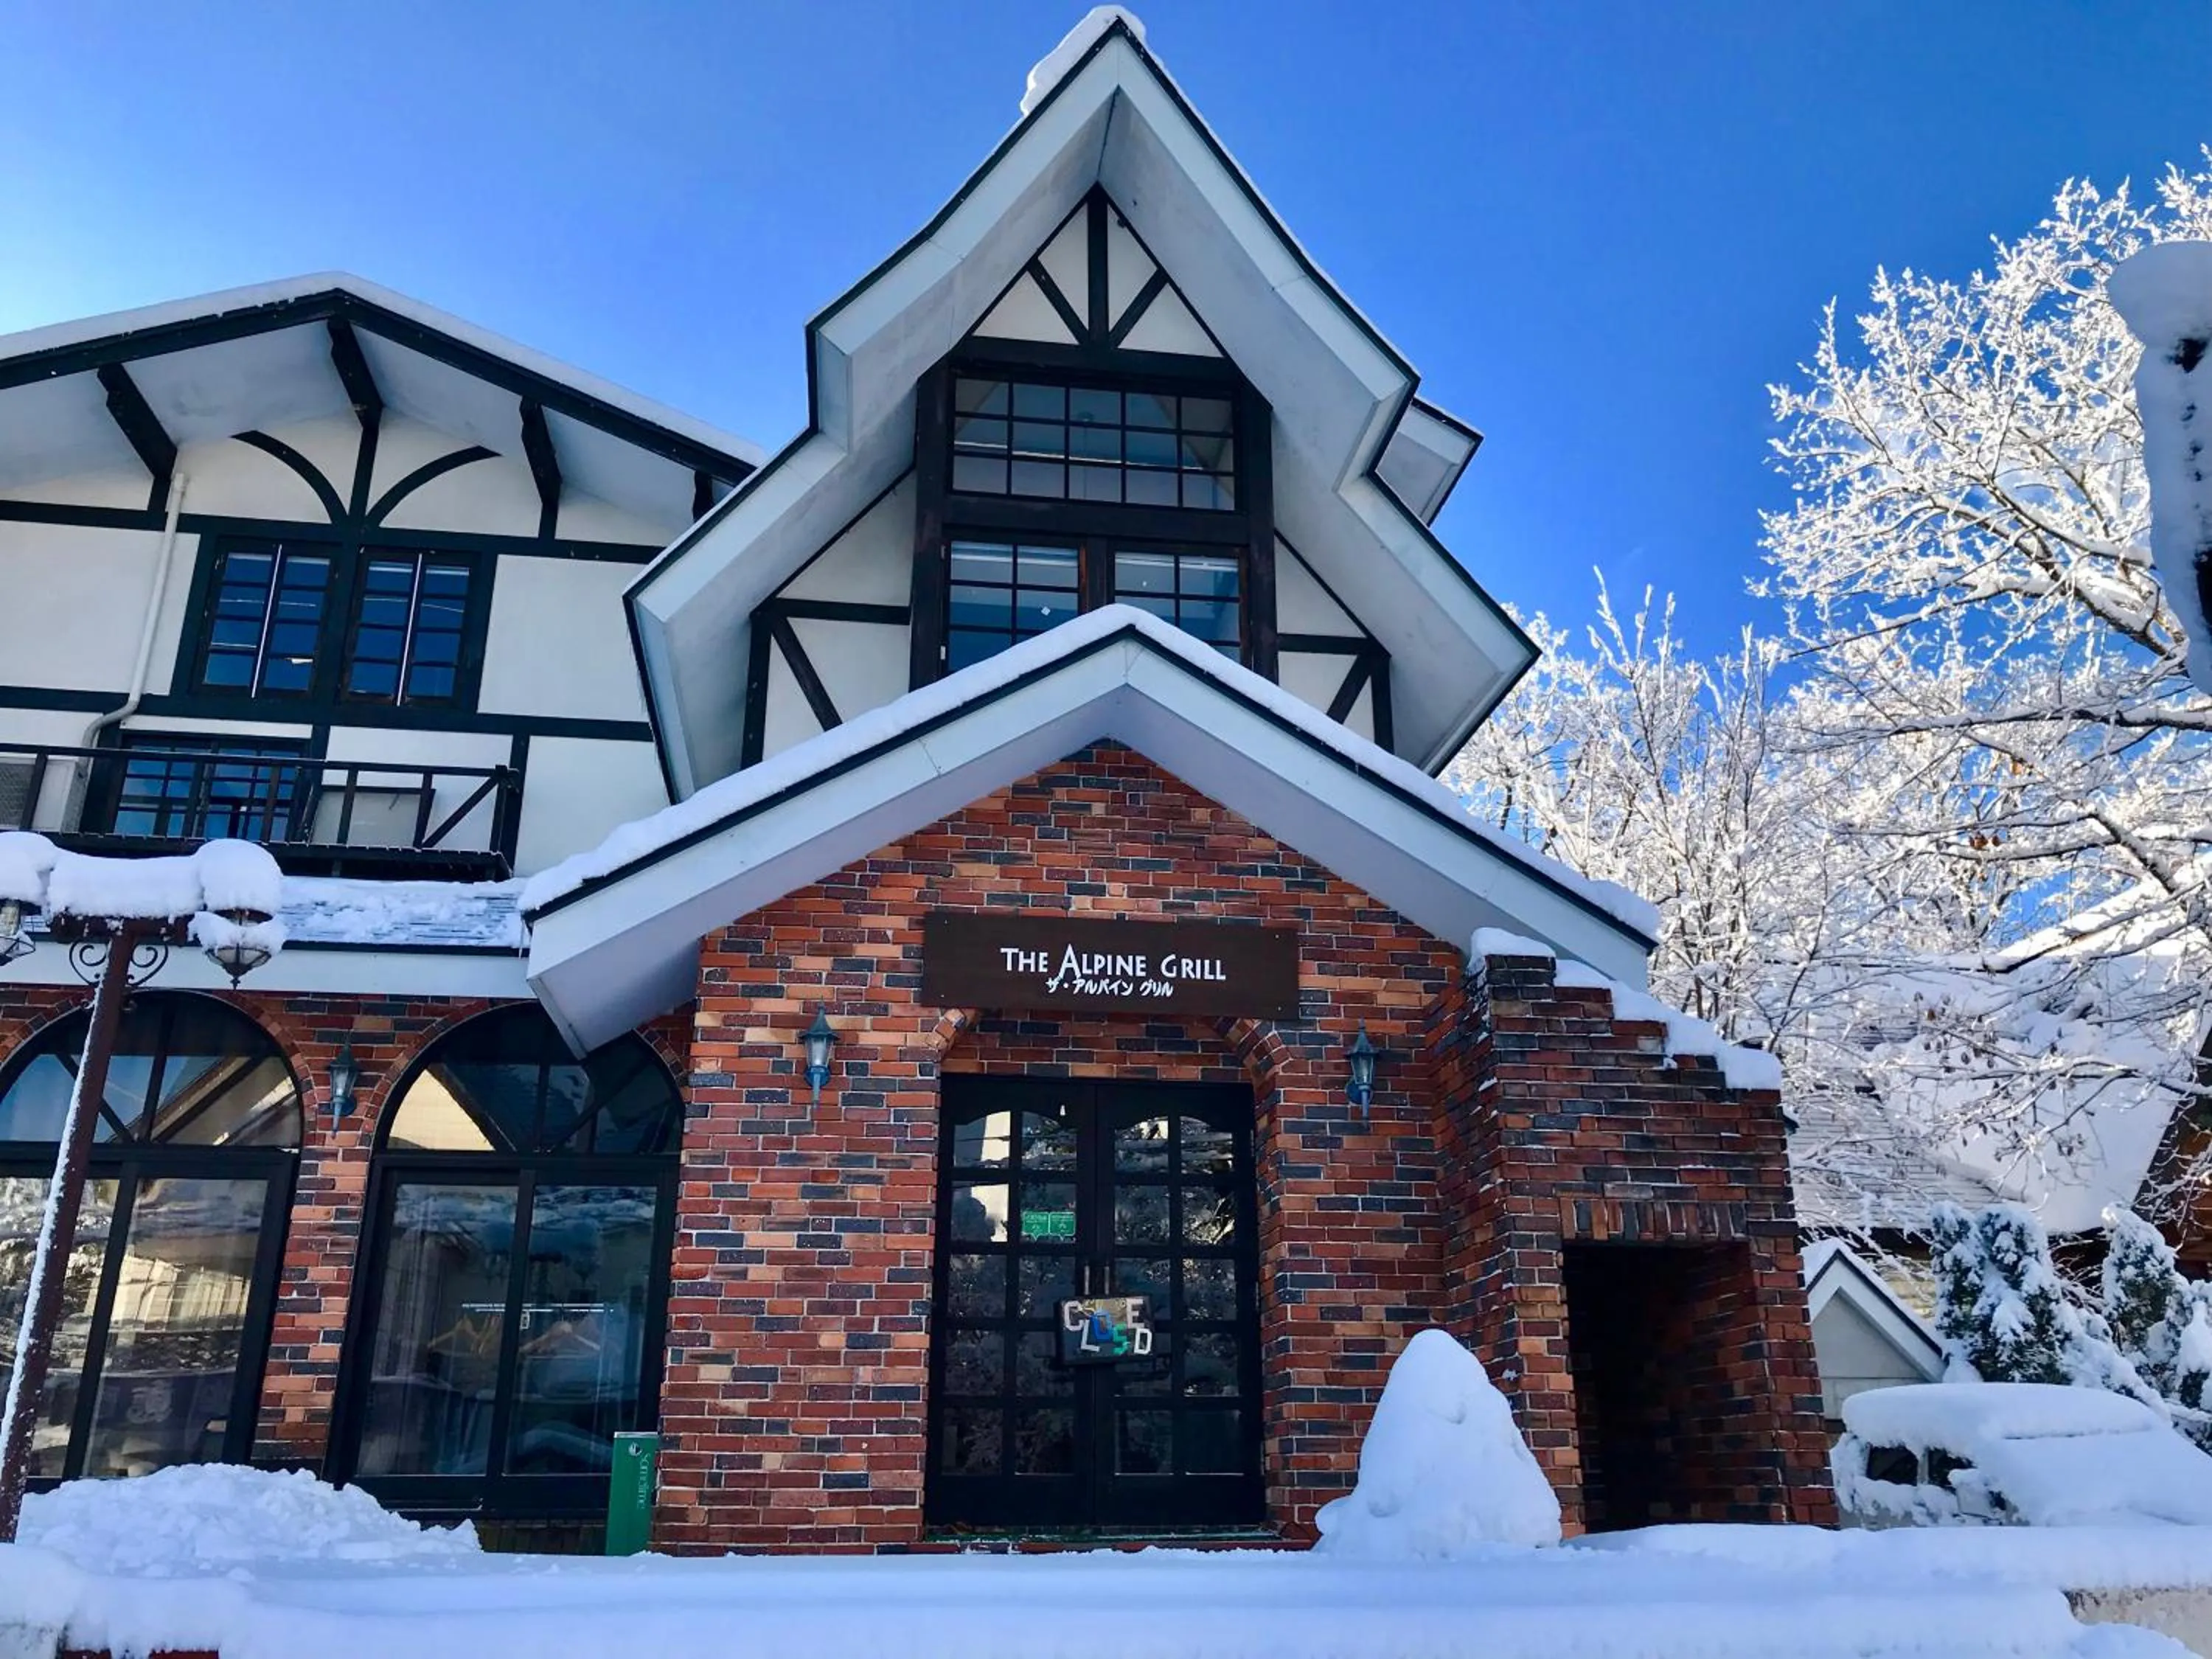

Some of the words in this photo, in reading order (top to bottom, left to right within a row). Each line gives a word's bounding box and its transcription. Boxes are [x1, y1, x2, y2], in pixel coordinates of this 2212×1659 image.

[1000, 947, 1048, 973] THE
[1057, 943, 1147, 979] ALPINE
[1161, 954, 1226, 980] GRILL
